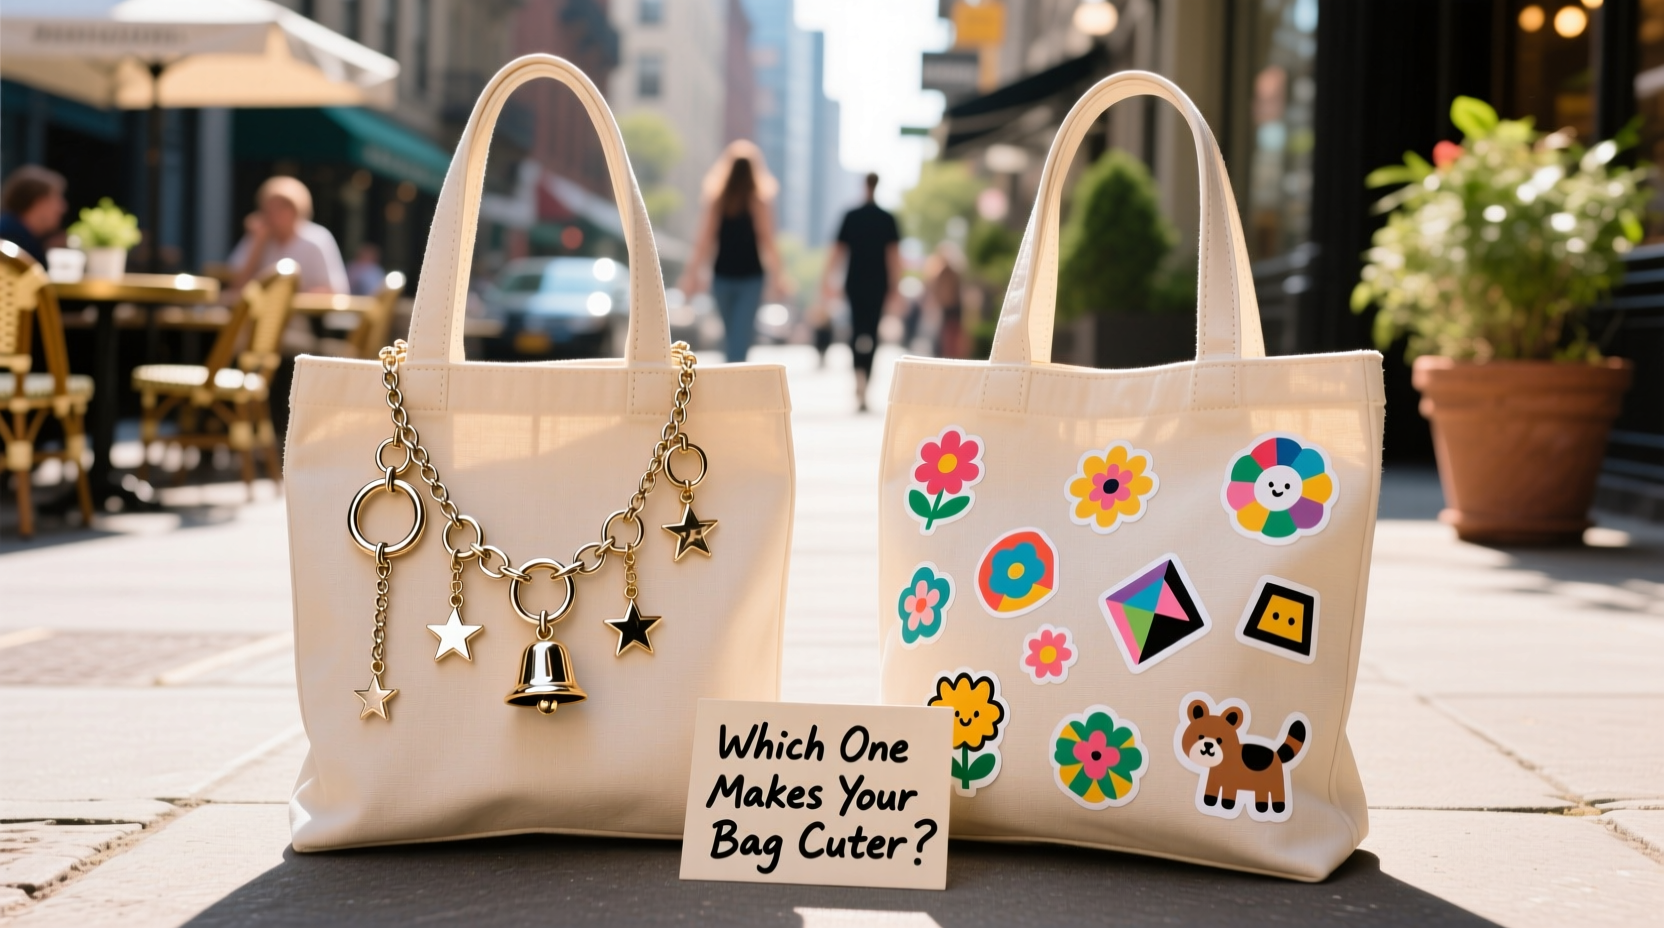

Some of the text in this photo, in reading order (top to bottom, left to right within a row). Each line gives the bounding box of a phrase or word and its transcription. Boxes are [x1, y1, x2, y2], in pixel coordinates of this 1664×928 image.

[718, 721, 909, 763] Which One
[705, 773, 918, 817] Makes Your
[710, 818, 938, 875] Bag Cuter?
